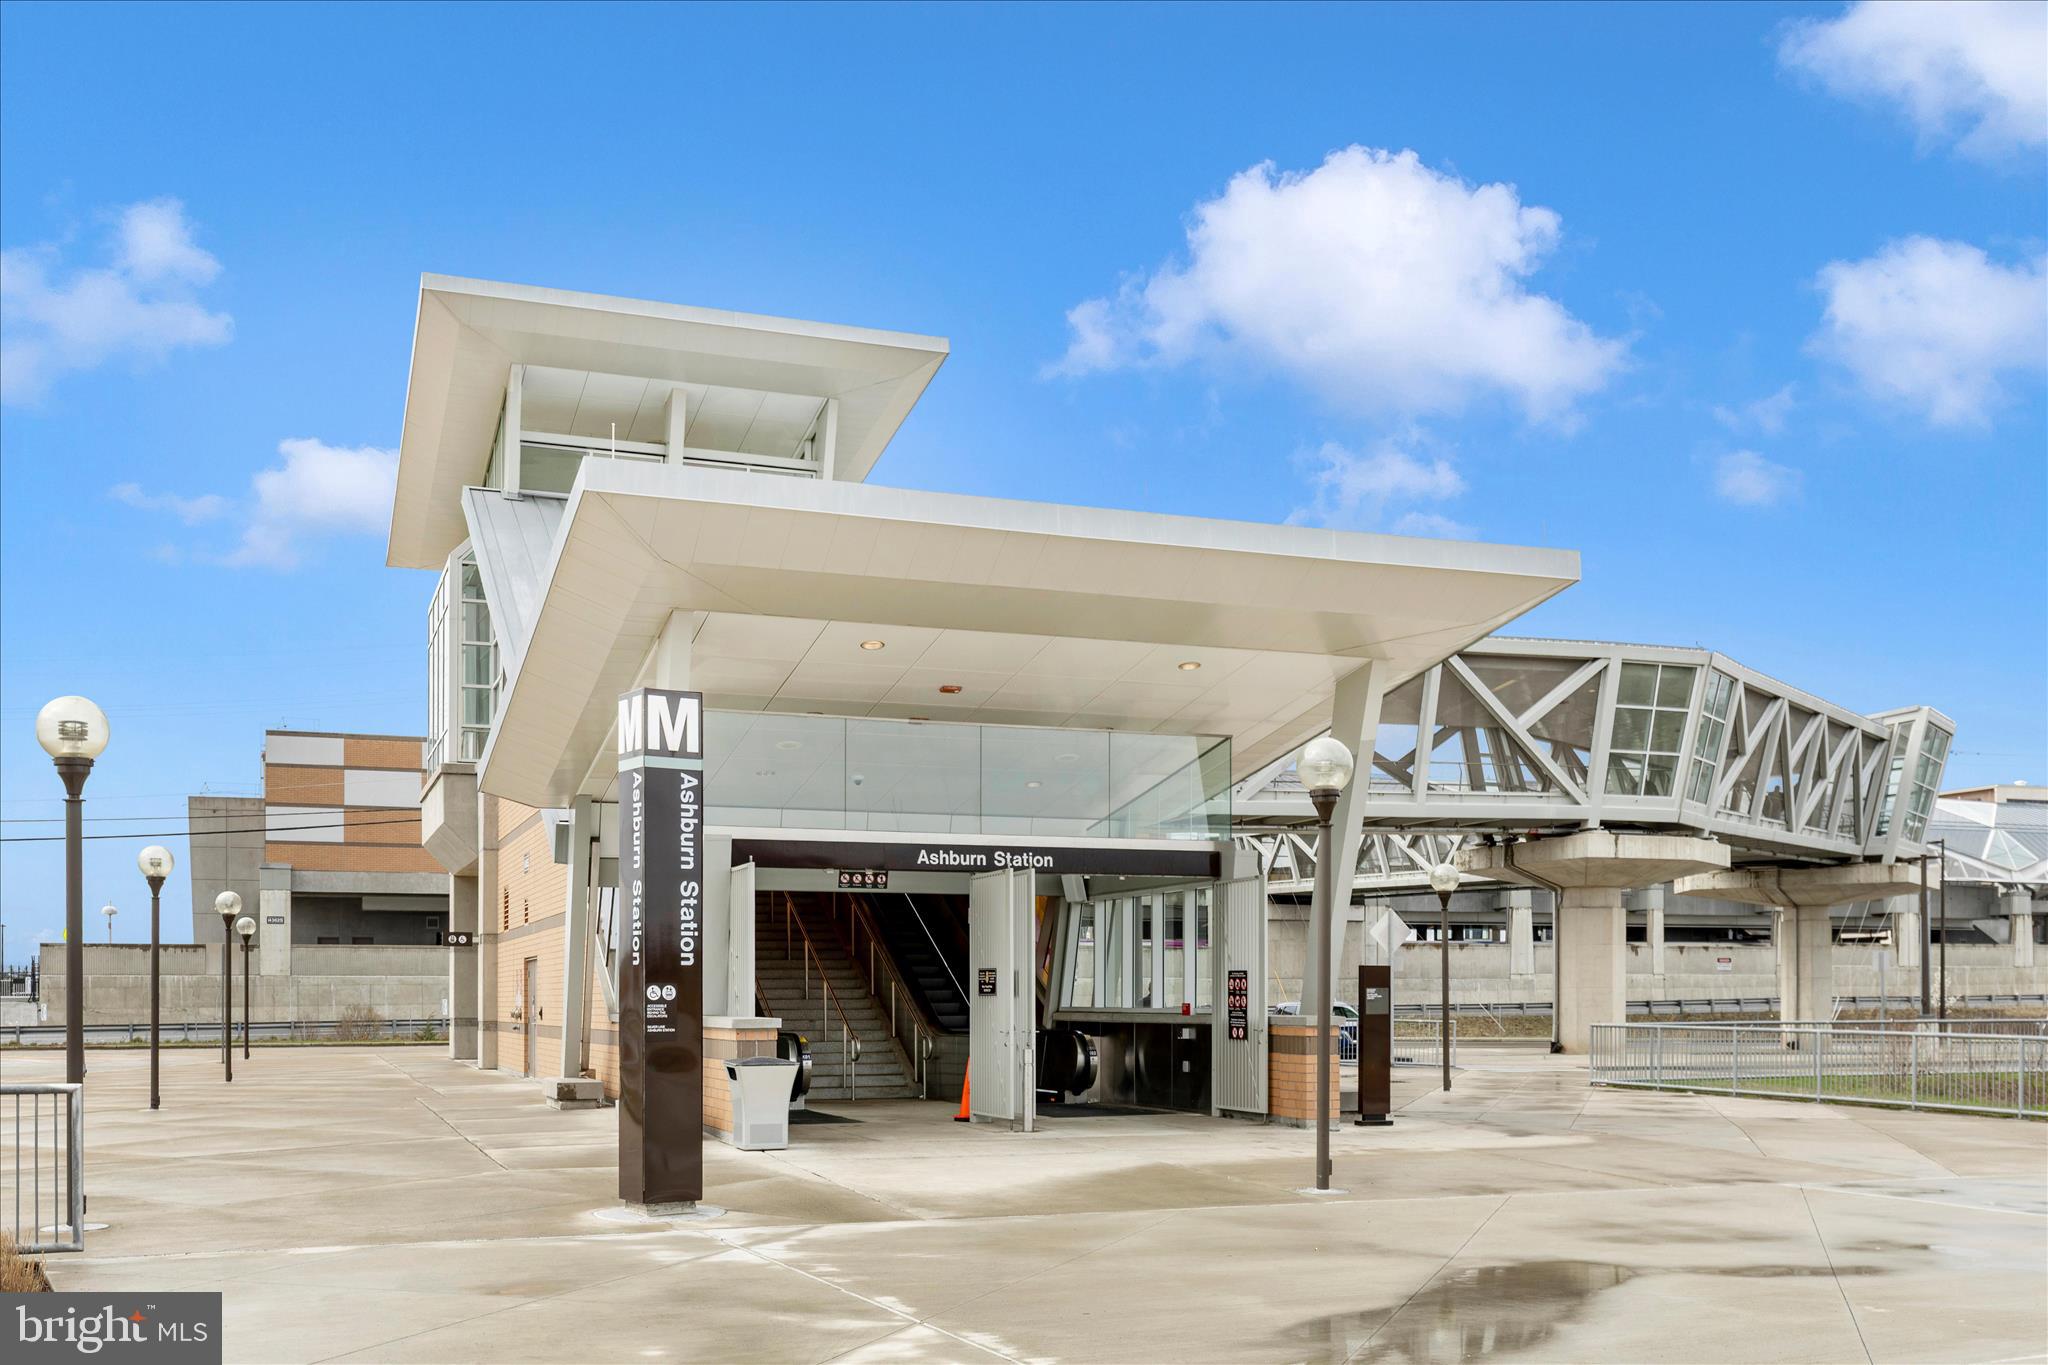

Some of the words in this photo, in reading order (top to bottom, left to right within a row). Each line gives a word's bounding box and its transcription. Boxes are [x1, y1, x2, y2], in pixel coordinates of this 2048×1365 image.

[618, 694, 642, 755] M
[647, 694, 699, 753] M
[632, 772, 642, 869] Ashburn
[680, 772, 699, 870] Ashburn
[917, 849, 987, 866] Ashburn
[994, 851, 1053, 868] Station
[632, 879, 642, 966] Station
[680, 880, 699, 966] Station
